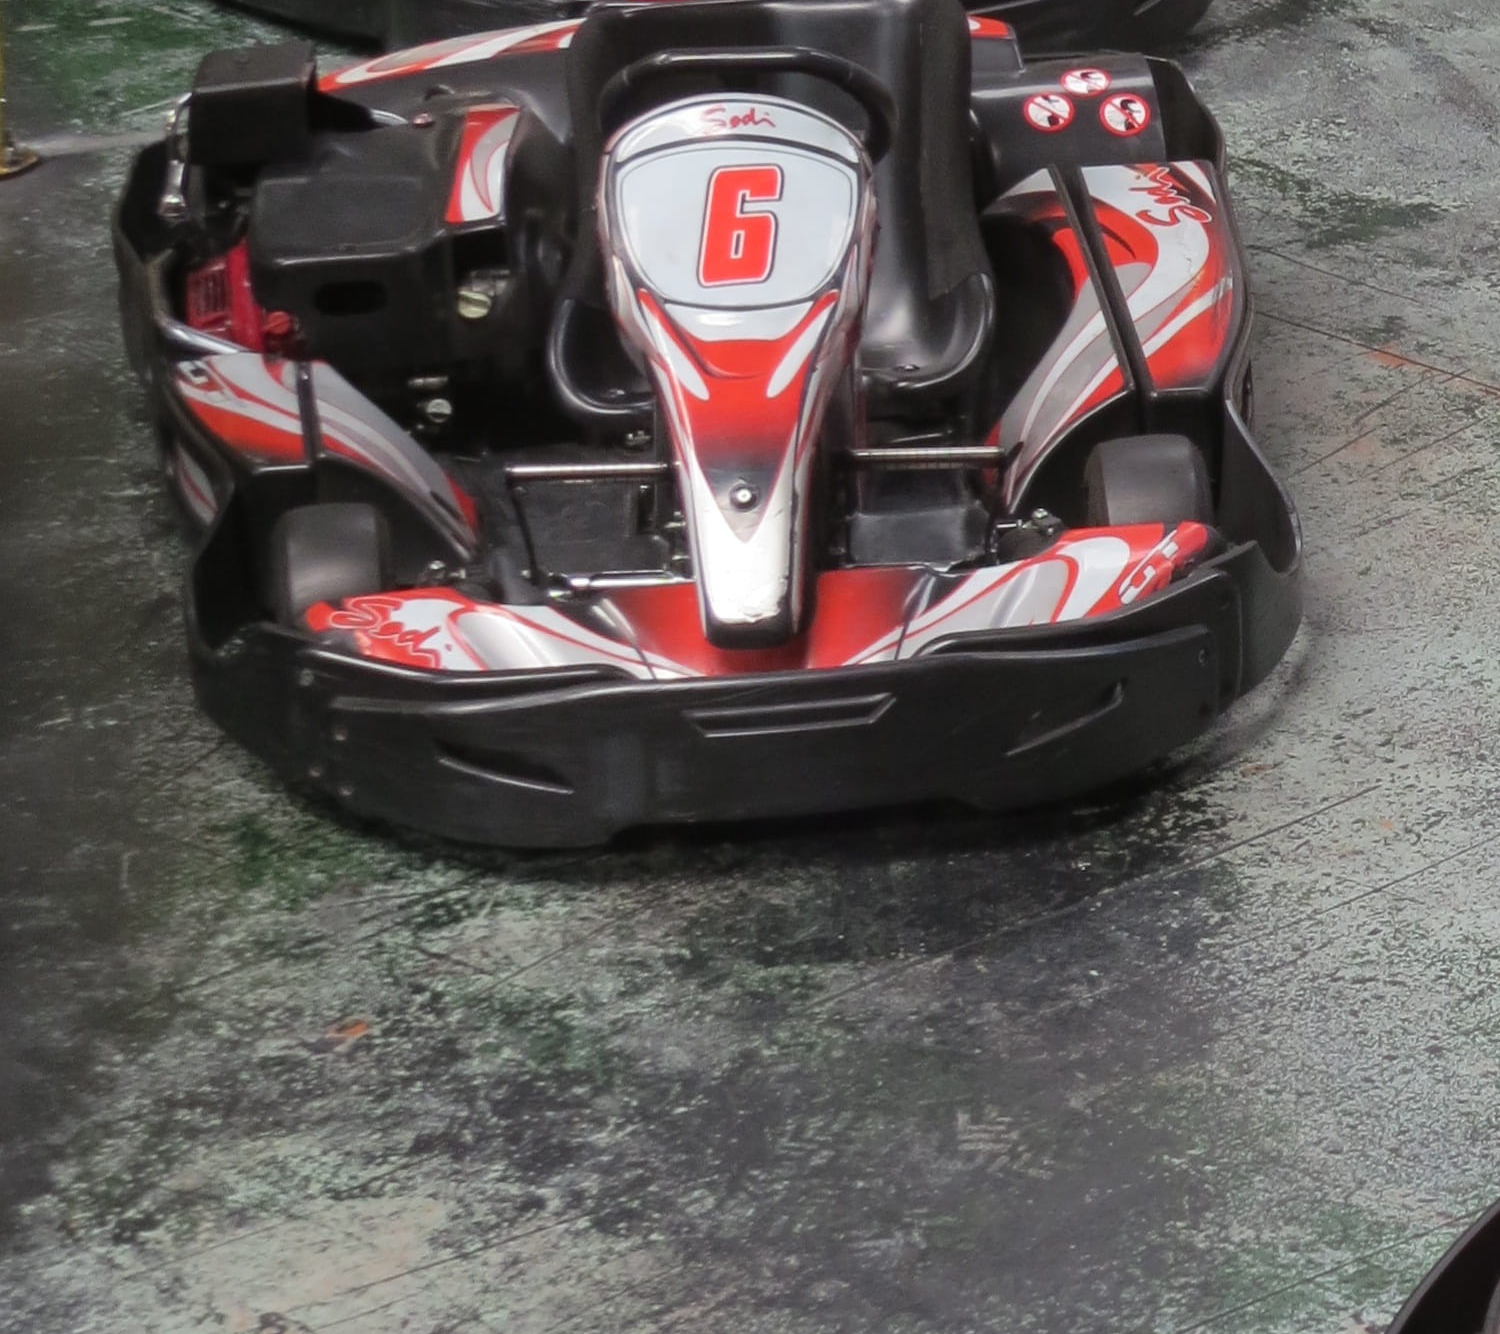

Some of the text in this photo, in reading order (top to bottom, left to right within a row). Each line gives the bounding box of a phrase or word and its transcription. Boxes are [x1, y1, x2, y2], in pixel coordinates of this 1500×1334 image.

[700, 105, 776, 135] Sodi
[697, 163, 785, 288] 6
[1128, 167, 1213, 228] Sodi
[328, 595, 452, 669] Sodi
